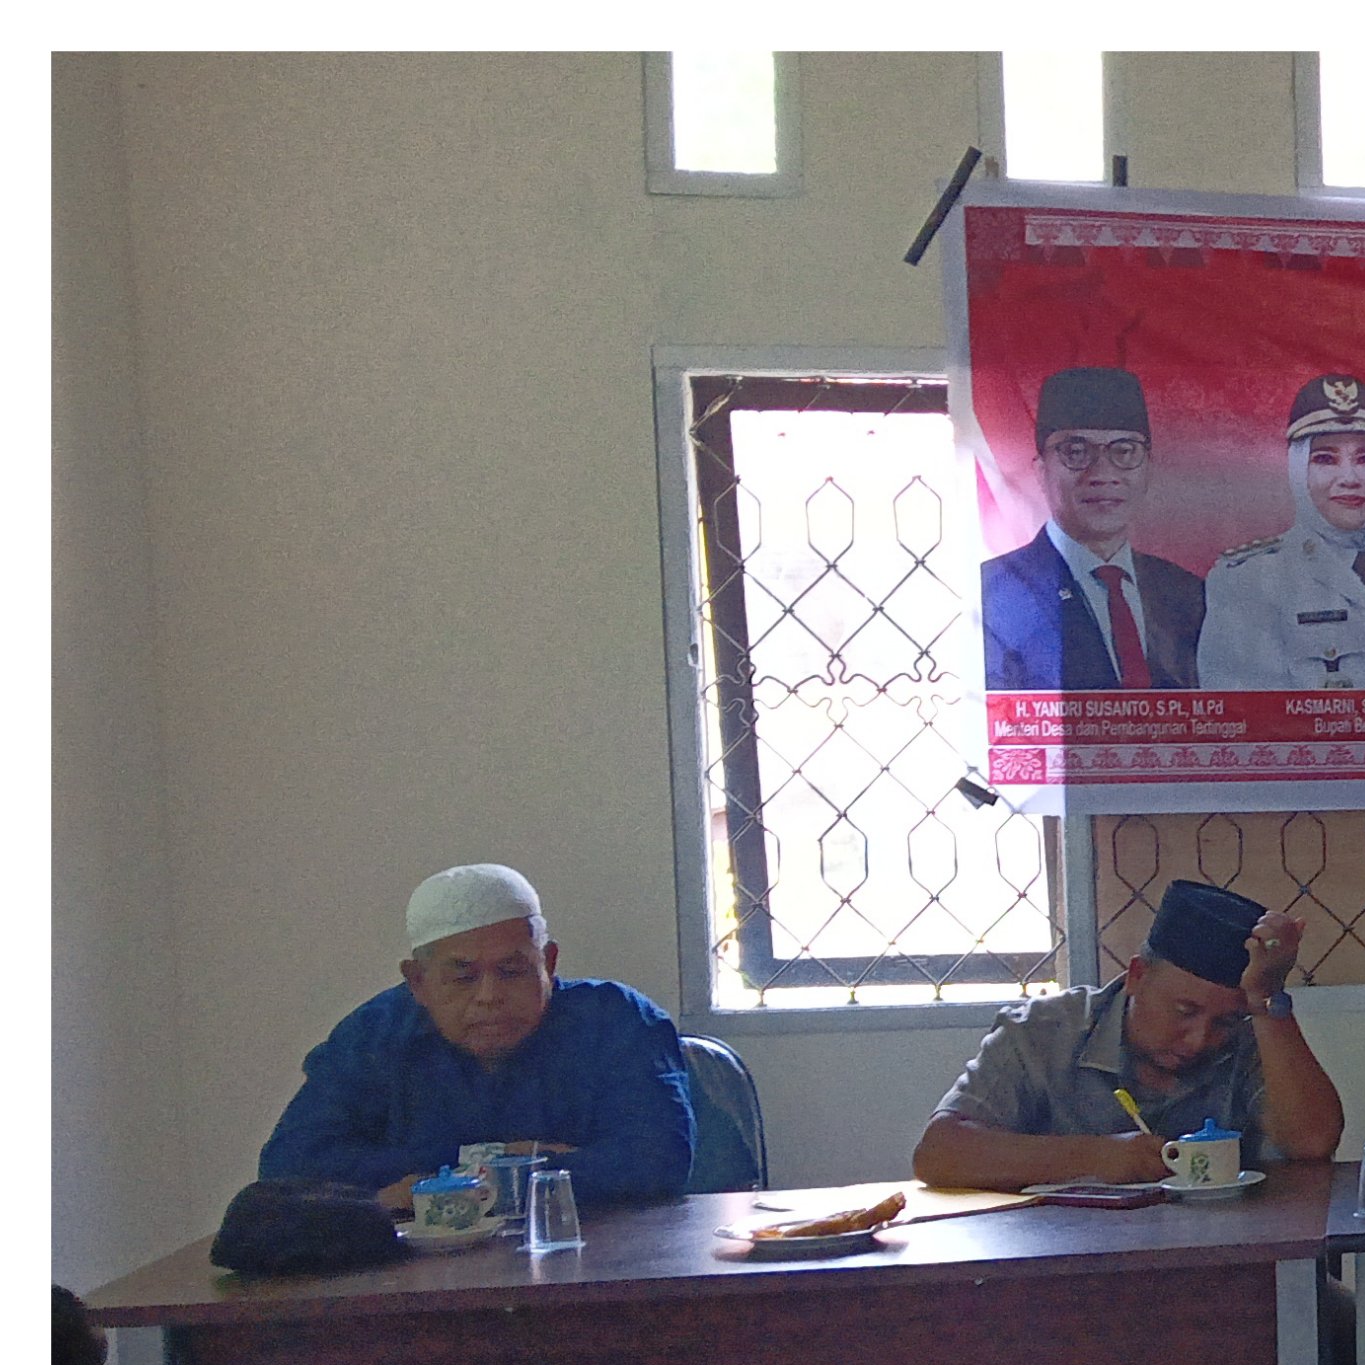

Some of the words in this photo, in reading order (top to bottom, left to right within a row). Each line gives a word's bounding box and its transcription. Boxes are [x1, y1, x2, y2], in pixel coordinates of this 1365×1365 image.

[1015, 701, 1031, 717] H.
[1033, 701, 1082, 717] YANDRI
[1085, 700, 1153, 718] SUSANTO,
[1193, 699, 1224, 716] M.Pd
[994, 720, 1039, 738] Menteri
[1042, 720, 1073, 737] Desa
[1075, 720, 1099, 737] dan
[1101, 719, 1187, 739] Pembangunan
